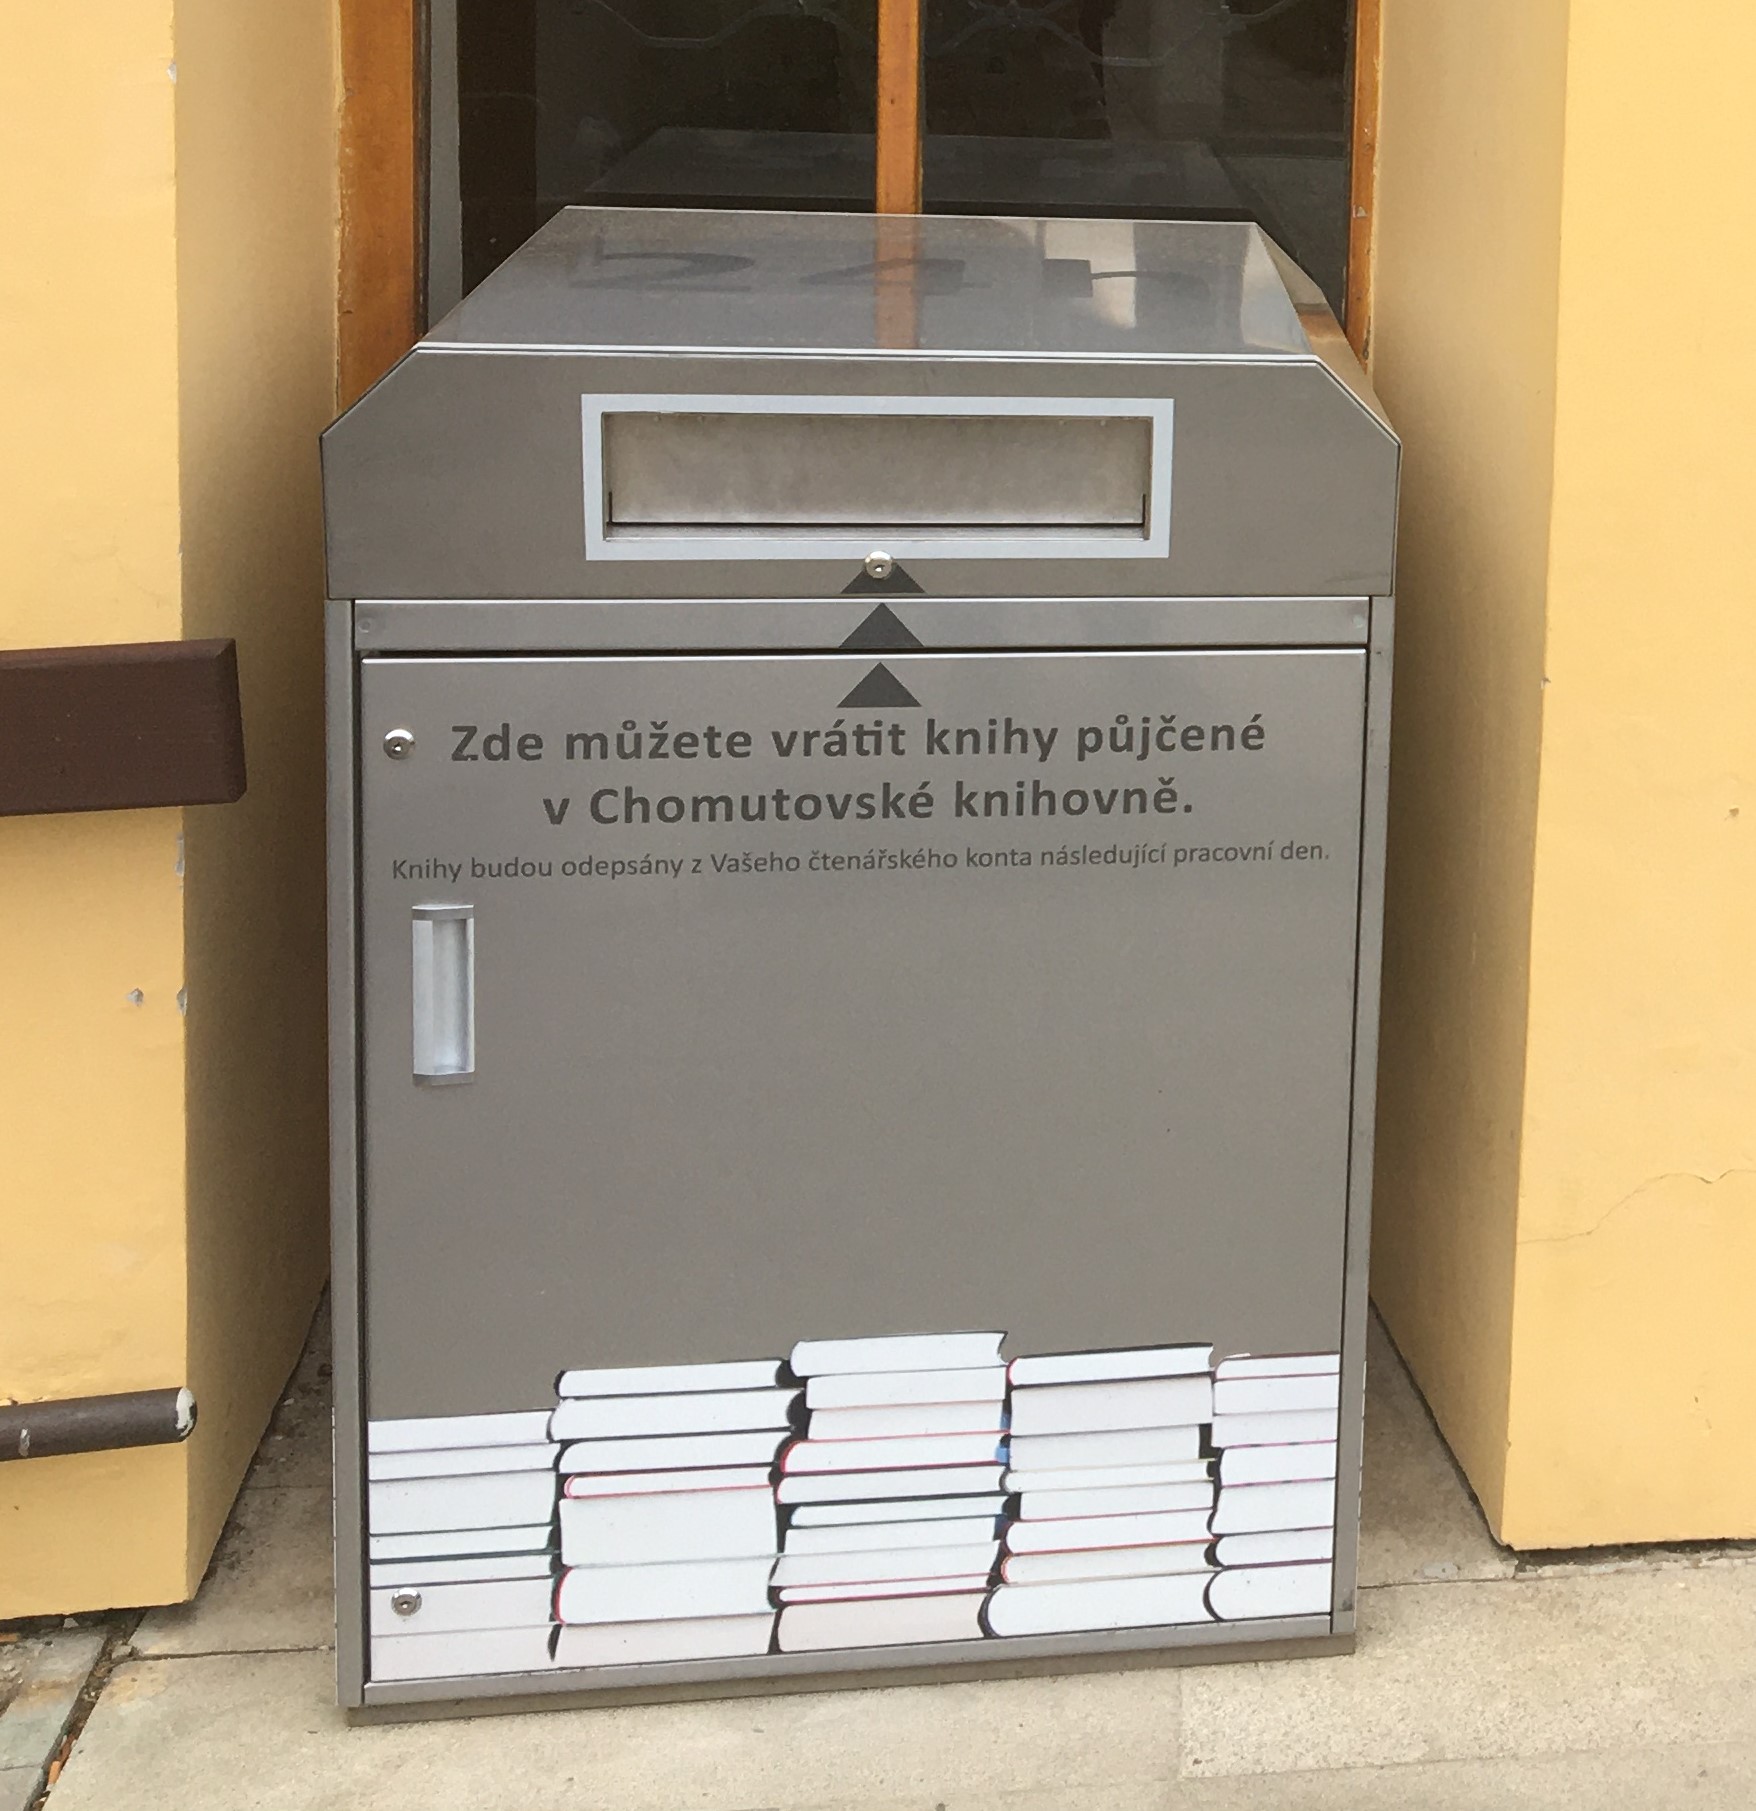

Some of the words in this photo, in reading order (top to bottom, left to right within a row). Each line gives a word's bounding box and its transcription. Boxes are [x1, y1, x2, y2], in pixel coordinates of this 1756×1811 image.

[452, 723, 543, 762] Zde
[566, 720, 752, 760] můžete
[771, 719, 906, 757] vrátit
[927, 717, 1058, 763] knihy
[1078, 714, 1265, 763] půjčené
[543, 797, 570, 825] v
[590, 780, 934, 825] Chomutovské
[955, 777, 1193, 818] knihovně.
[393, 859, 463, 883] Knihy
[470, 856, 552, 878] budou
[561, 853, 684, 883] odepsány
[691, 858, 703, 874] z
[709, 851, 800, 873] Vašeho
[808, 848, 958, 871] čtenářského
[966, 846, 1031, 868] konta
[1040, 842, 1167, 871] následující
[1173, 839, 1274, 868] pracovní
[1279, 839, 1330, 862] den.
